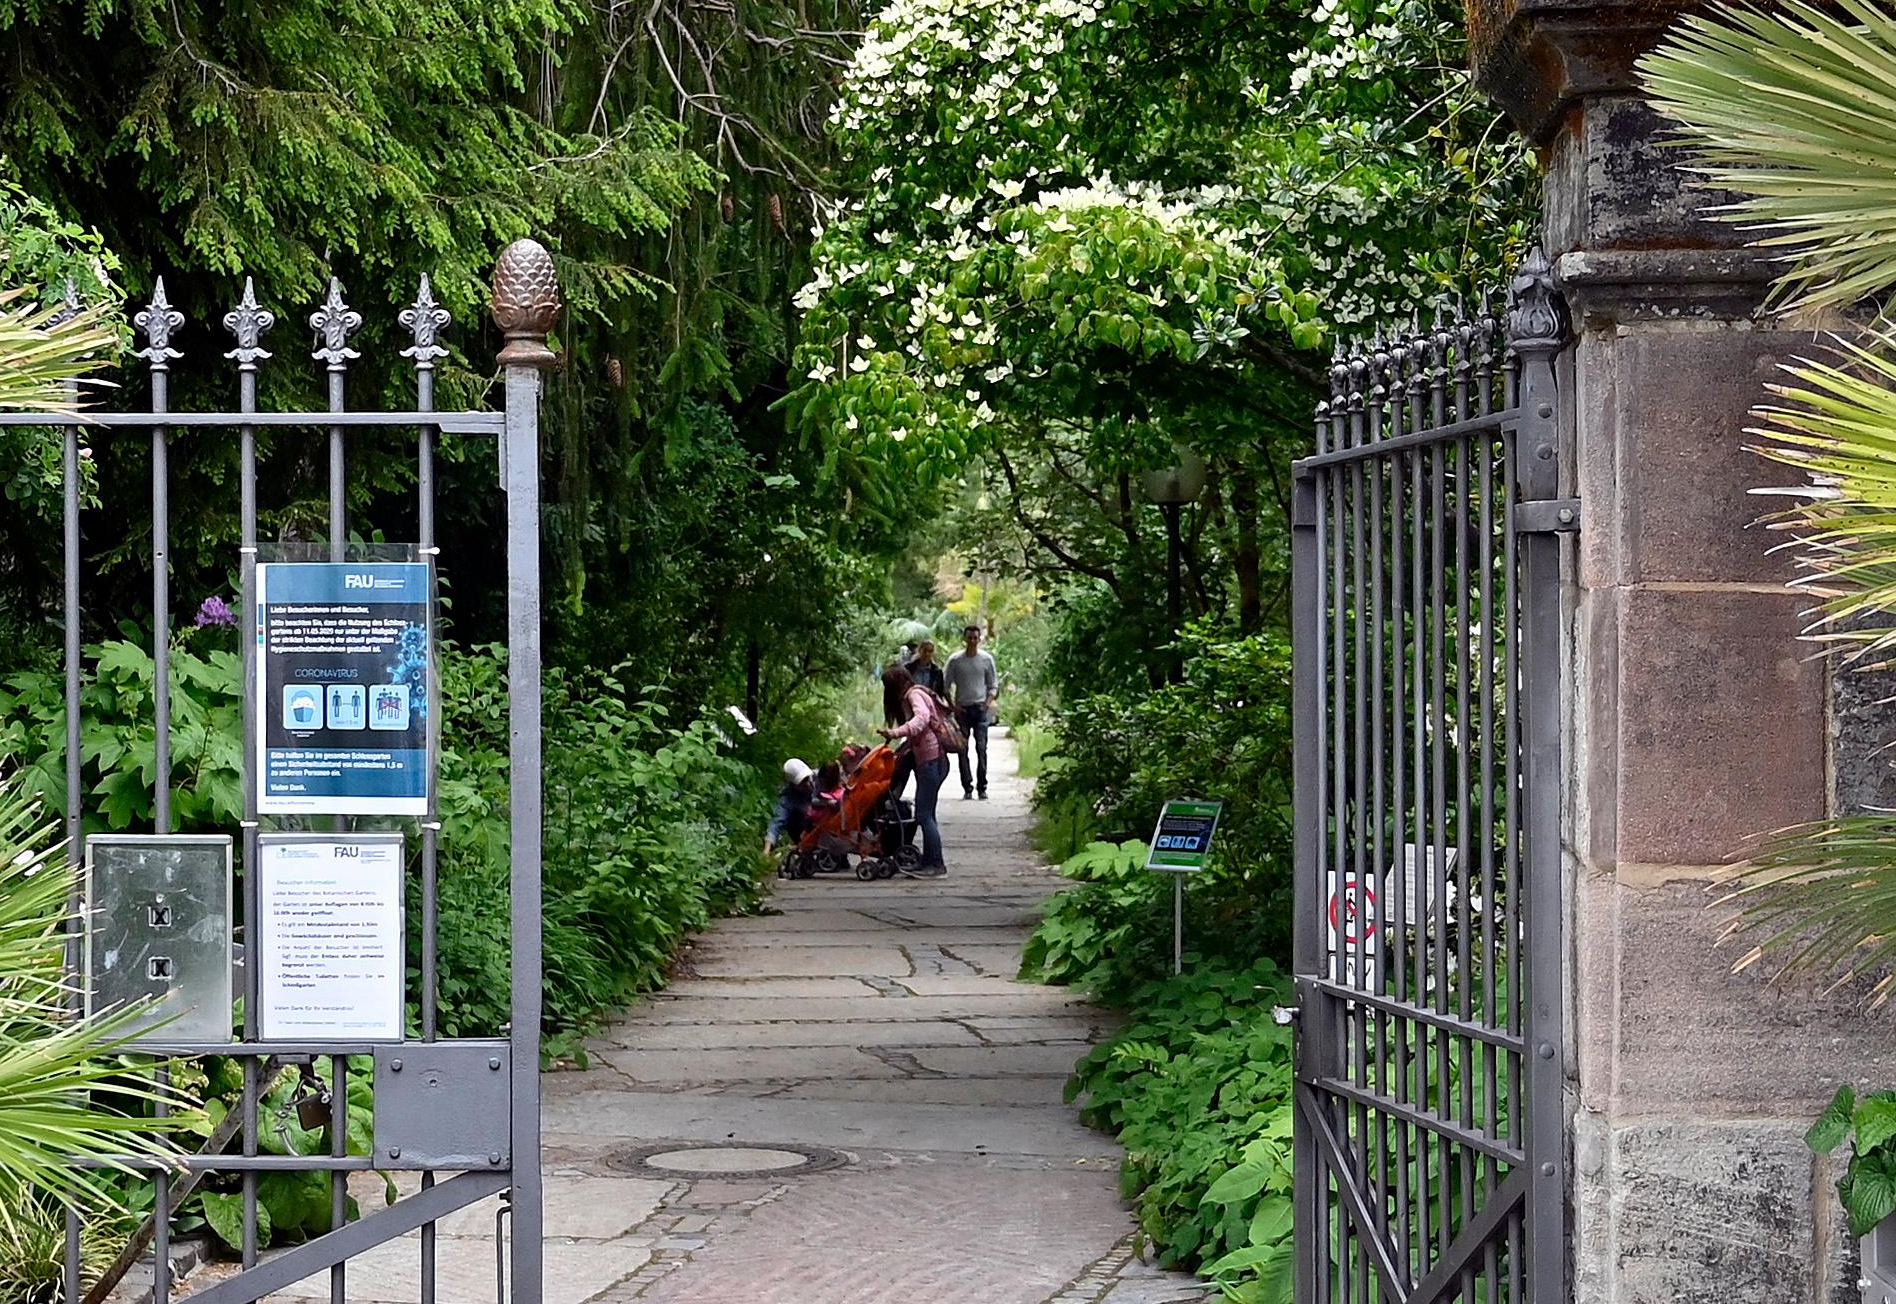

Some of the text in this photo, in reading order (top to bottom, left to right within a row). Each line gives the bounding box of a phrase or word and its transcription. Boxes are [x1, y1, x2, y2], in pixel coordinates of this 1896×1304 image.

[345, 574, 374, 588] FAU
[294, 668, 359, 678] CORONAVIRUS
[334, 847, 359, 858] FAU
